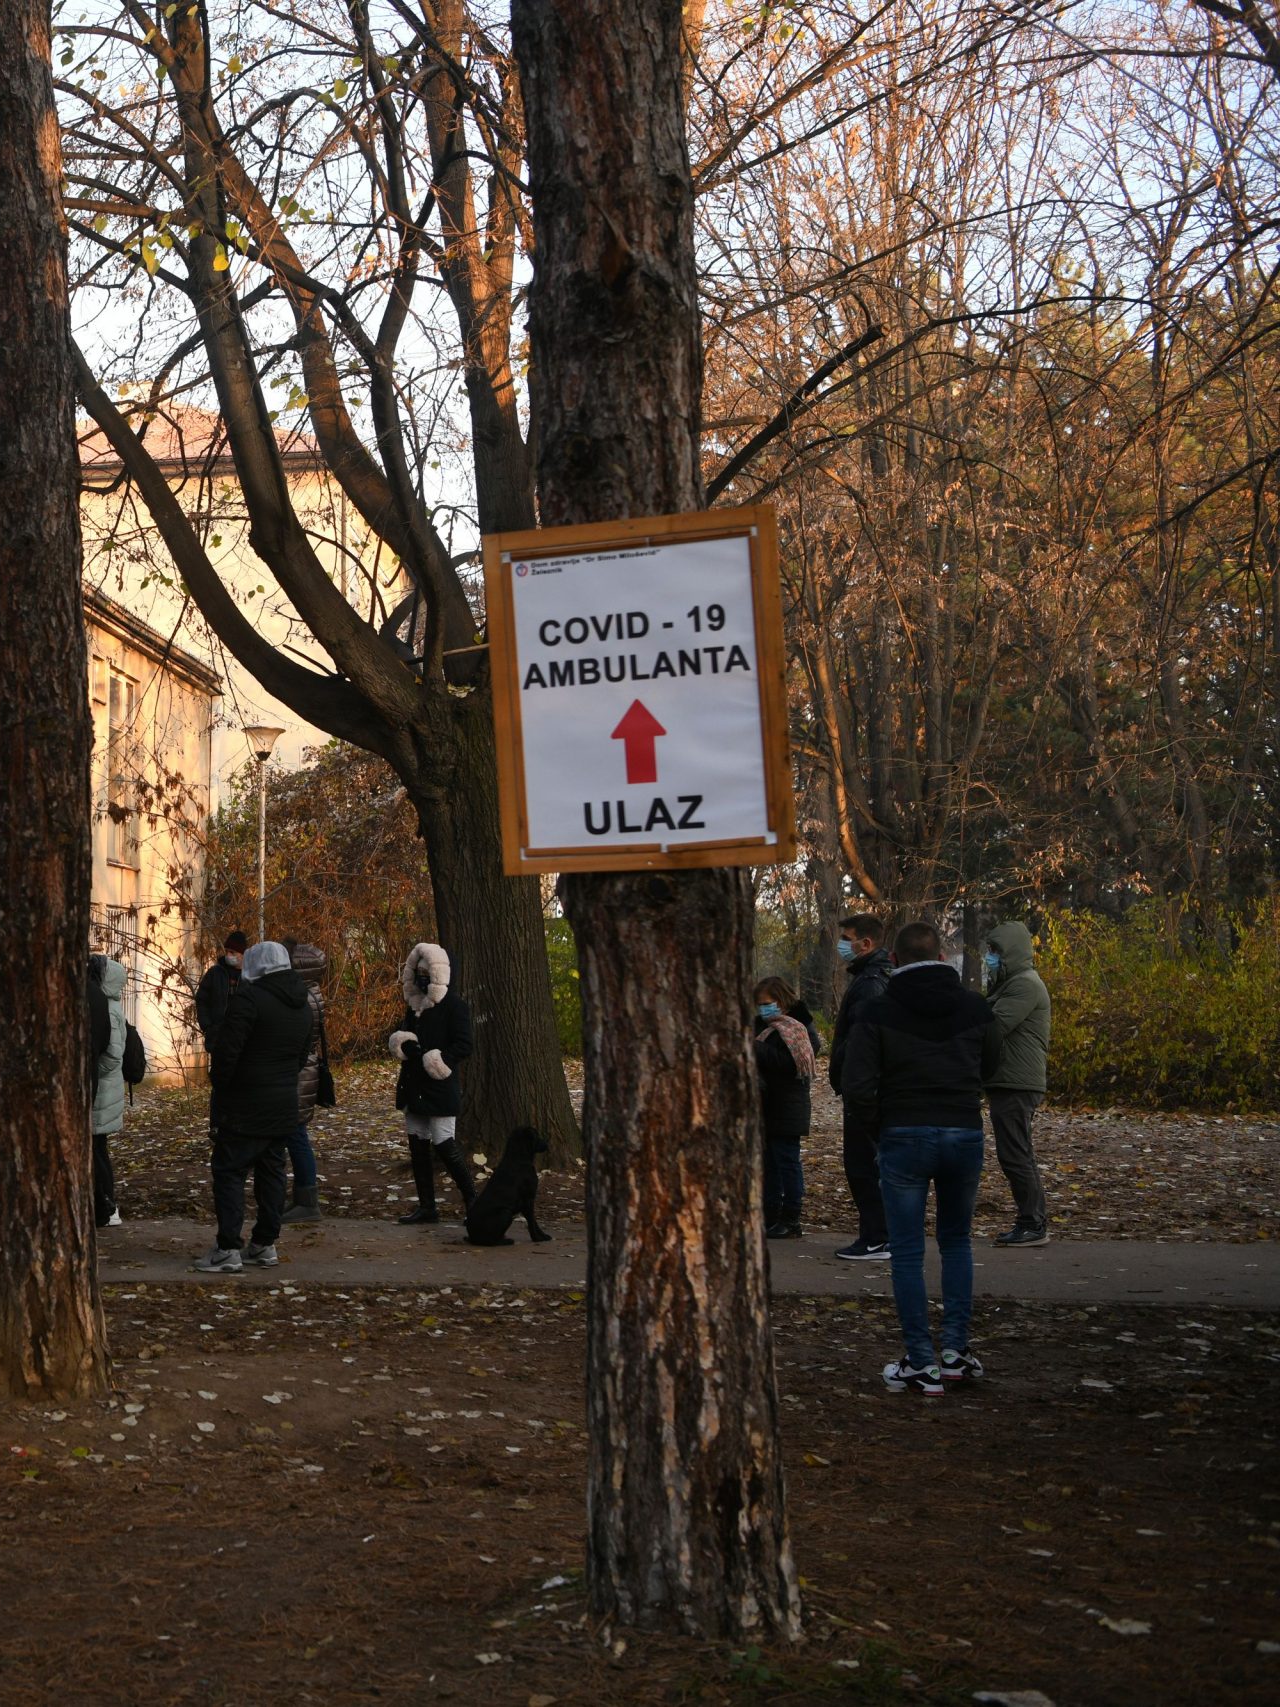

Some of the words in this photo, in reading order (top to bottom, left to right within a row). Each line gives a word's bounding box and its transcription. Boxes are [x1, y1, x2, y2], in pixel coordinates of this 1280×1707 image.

[539, 611, 651, 647] COVID
[687, 603, 726, 634] 19
[523, 644, 751, 690] AMBULANTA
[583, 795, 706, 836] ULAZ
